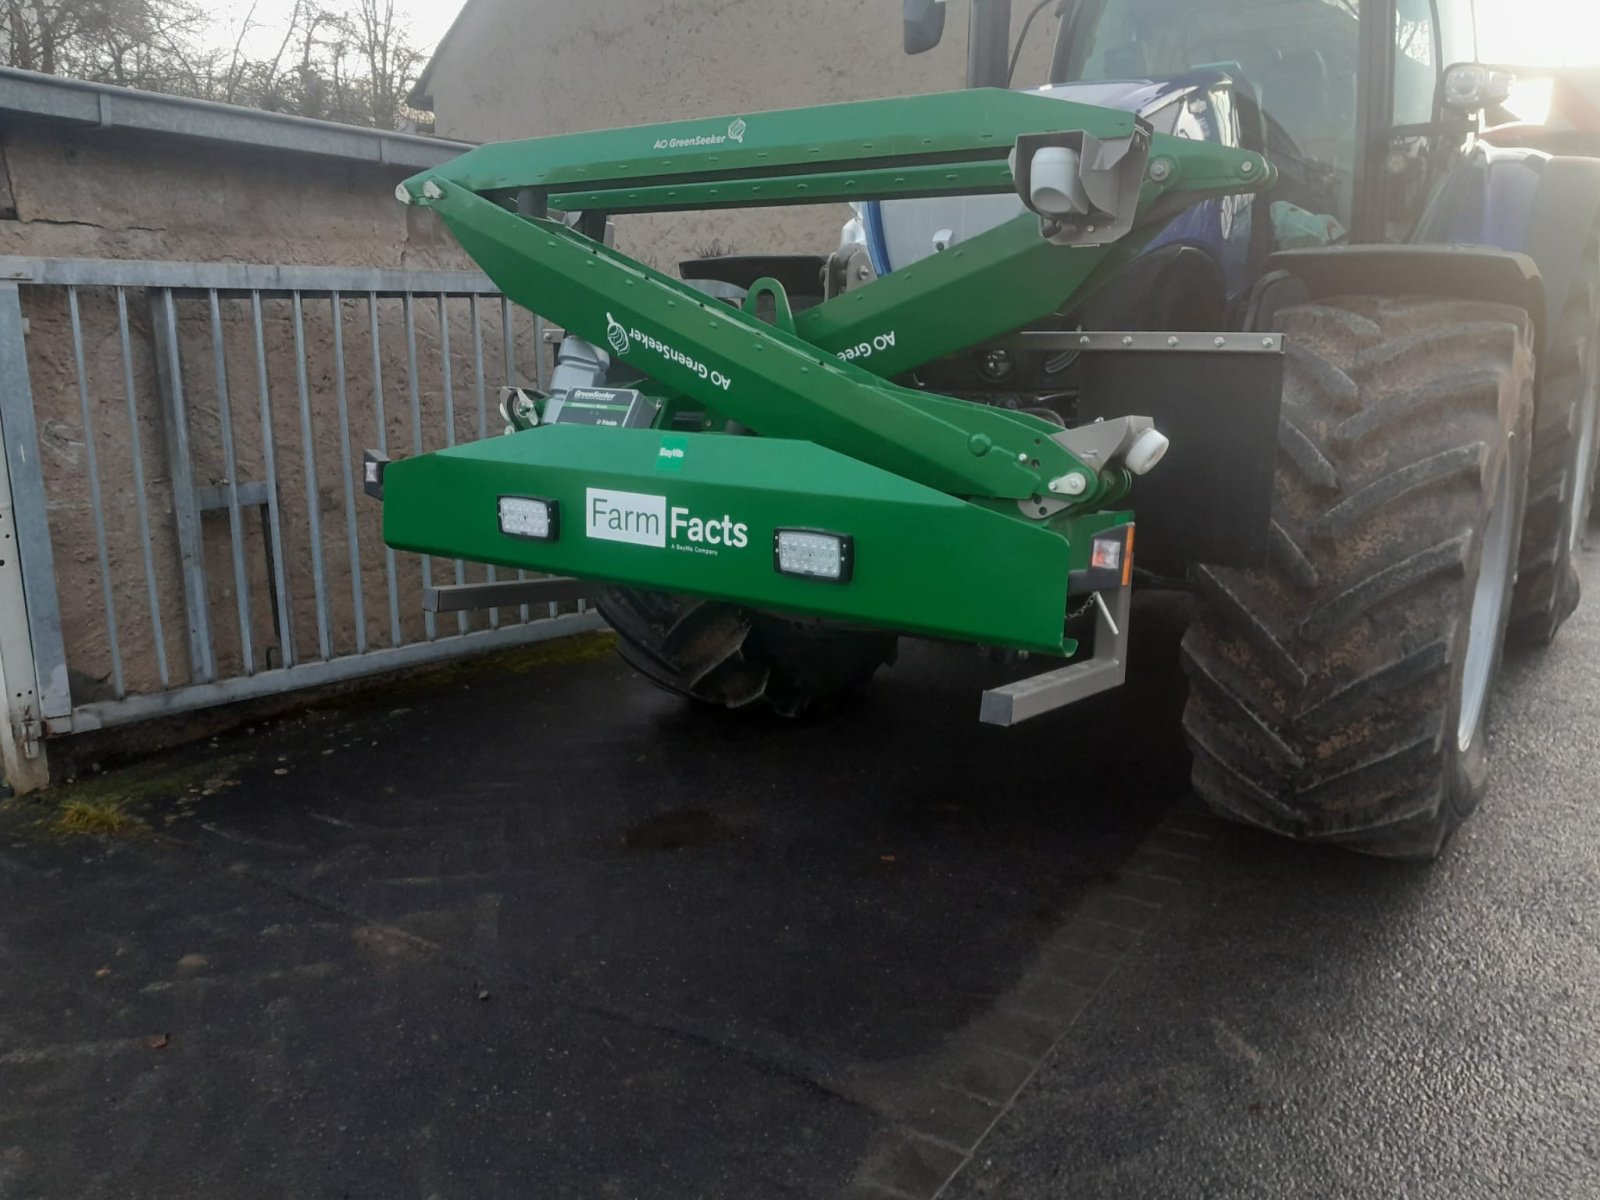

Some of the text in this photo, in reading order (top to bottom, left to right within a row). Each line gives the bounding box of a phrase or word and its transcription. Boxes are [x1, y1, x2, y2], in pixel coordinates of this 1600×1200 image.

[653, 134, 726, 150] AO GreenSeeker
[873, 330, 896, 351] AO
[629, 327, 731, 390] AO GreenSeeker
[592, 497, 748, 548] Farm Facts
[694, 546, 719, 556] Company
